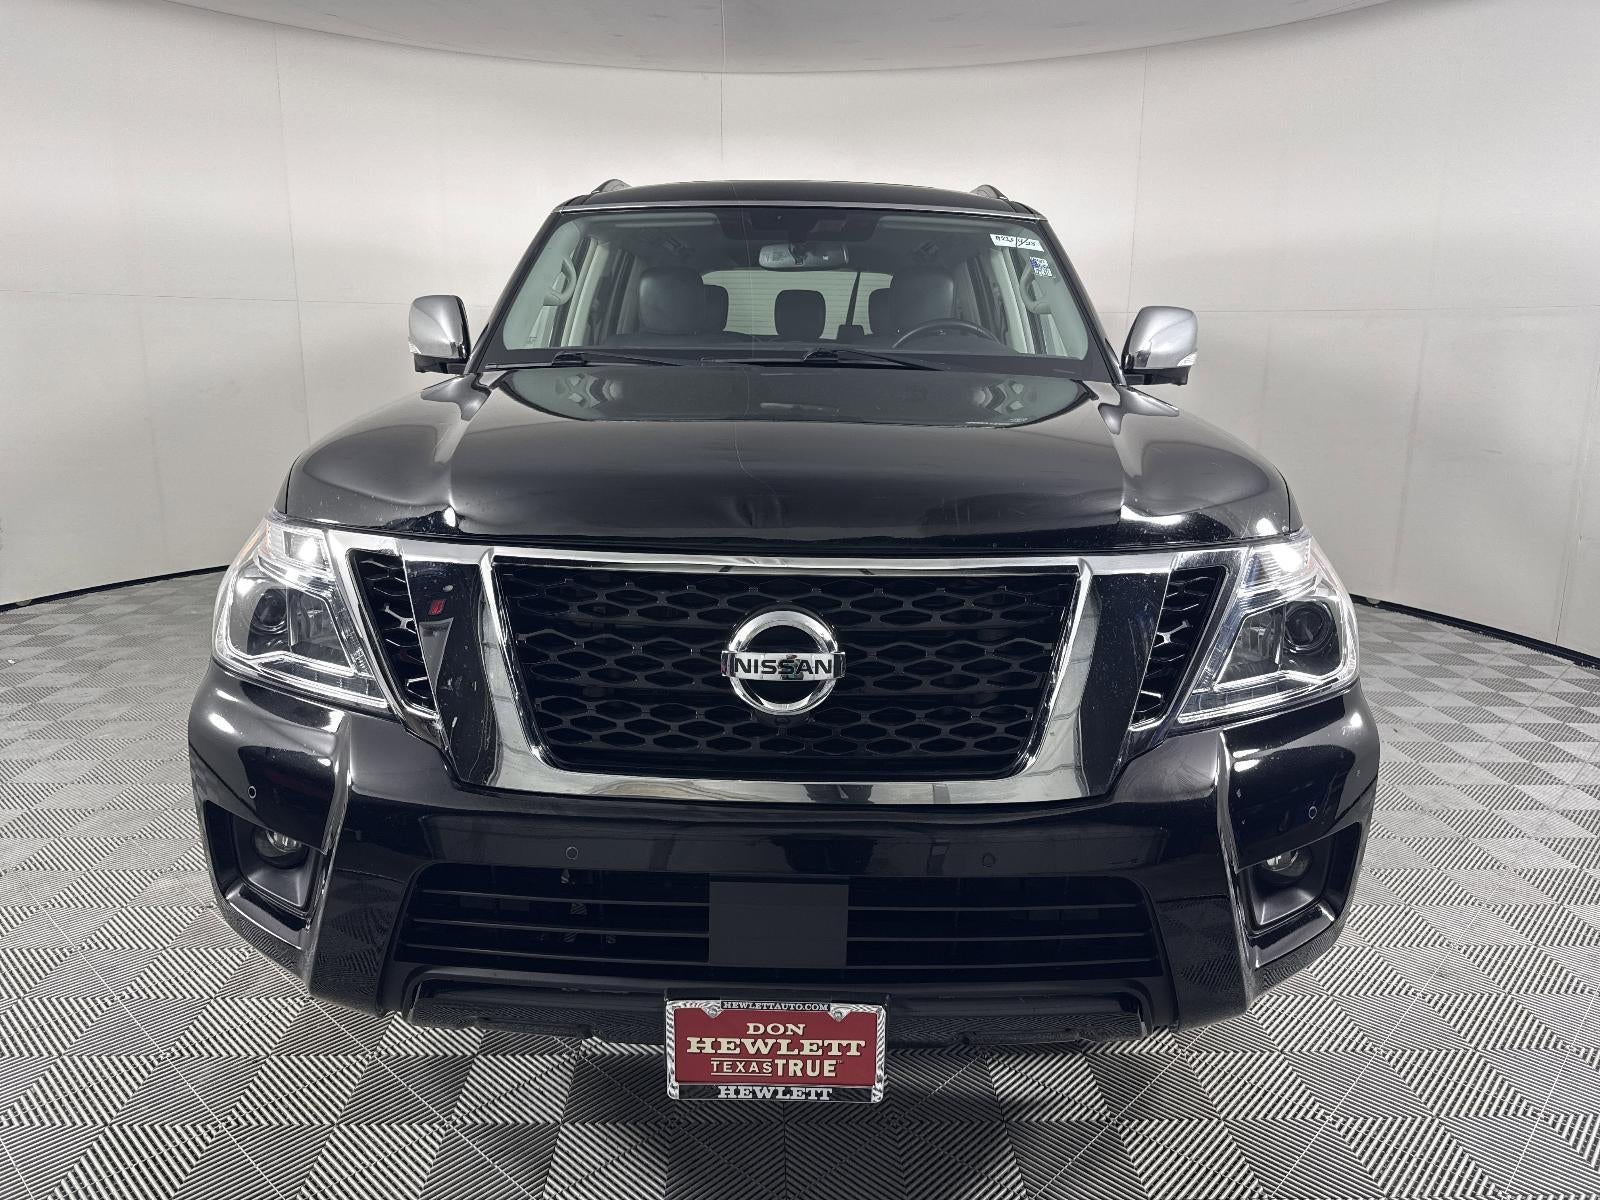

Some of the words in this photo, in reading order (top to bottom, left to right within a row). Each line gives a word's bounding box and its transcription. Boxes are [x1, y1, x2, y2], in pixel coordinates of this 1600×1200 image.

[735, 658, 832, 674] NISSAN
[722, 1002, 829, 1011] HEWLETTAUTO.COM
[747, 1023, 806, 1035] DON
[687, 1037, 866, 1056] HEWLETT
[711, 1061, 773, 1073] TEXAS
[775, 1059, 837, 1077] TRUE
[718, 1086, 833, 1100] HEWLETT
